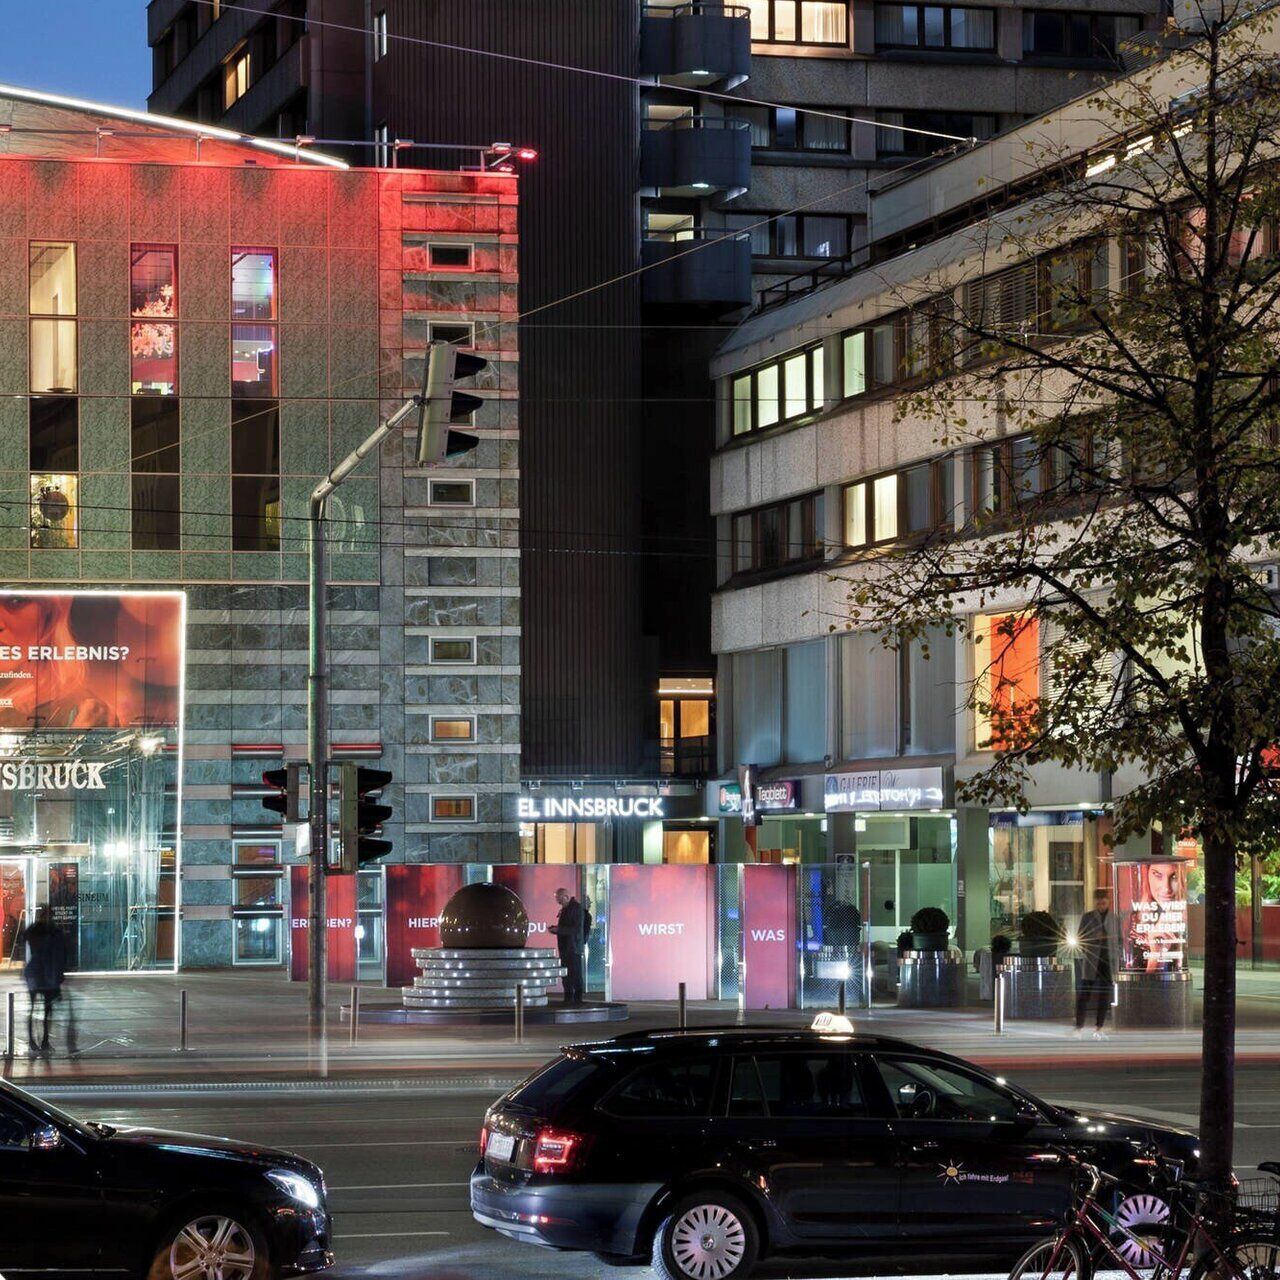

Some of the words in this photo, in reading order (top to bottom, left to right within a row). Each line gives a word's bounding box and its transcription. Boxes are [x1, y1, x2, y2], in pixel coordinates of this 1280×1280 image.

[28, 646, 130, 660] ERLEBNIS?
[757, 786, 787, 803] Tagblatt
[545, 797, 664, 817] INNSBRUCK
[1132, 902, 1158, 911] WAS
[408, 918, 438, 928] HIER
[1142, 912, 1158, 922] DU
[528, 923, 547, 933] DU
[638, 923, 685, 936] WIRST
[751, 929, 785, 942] WAS
